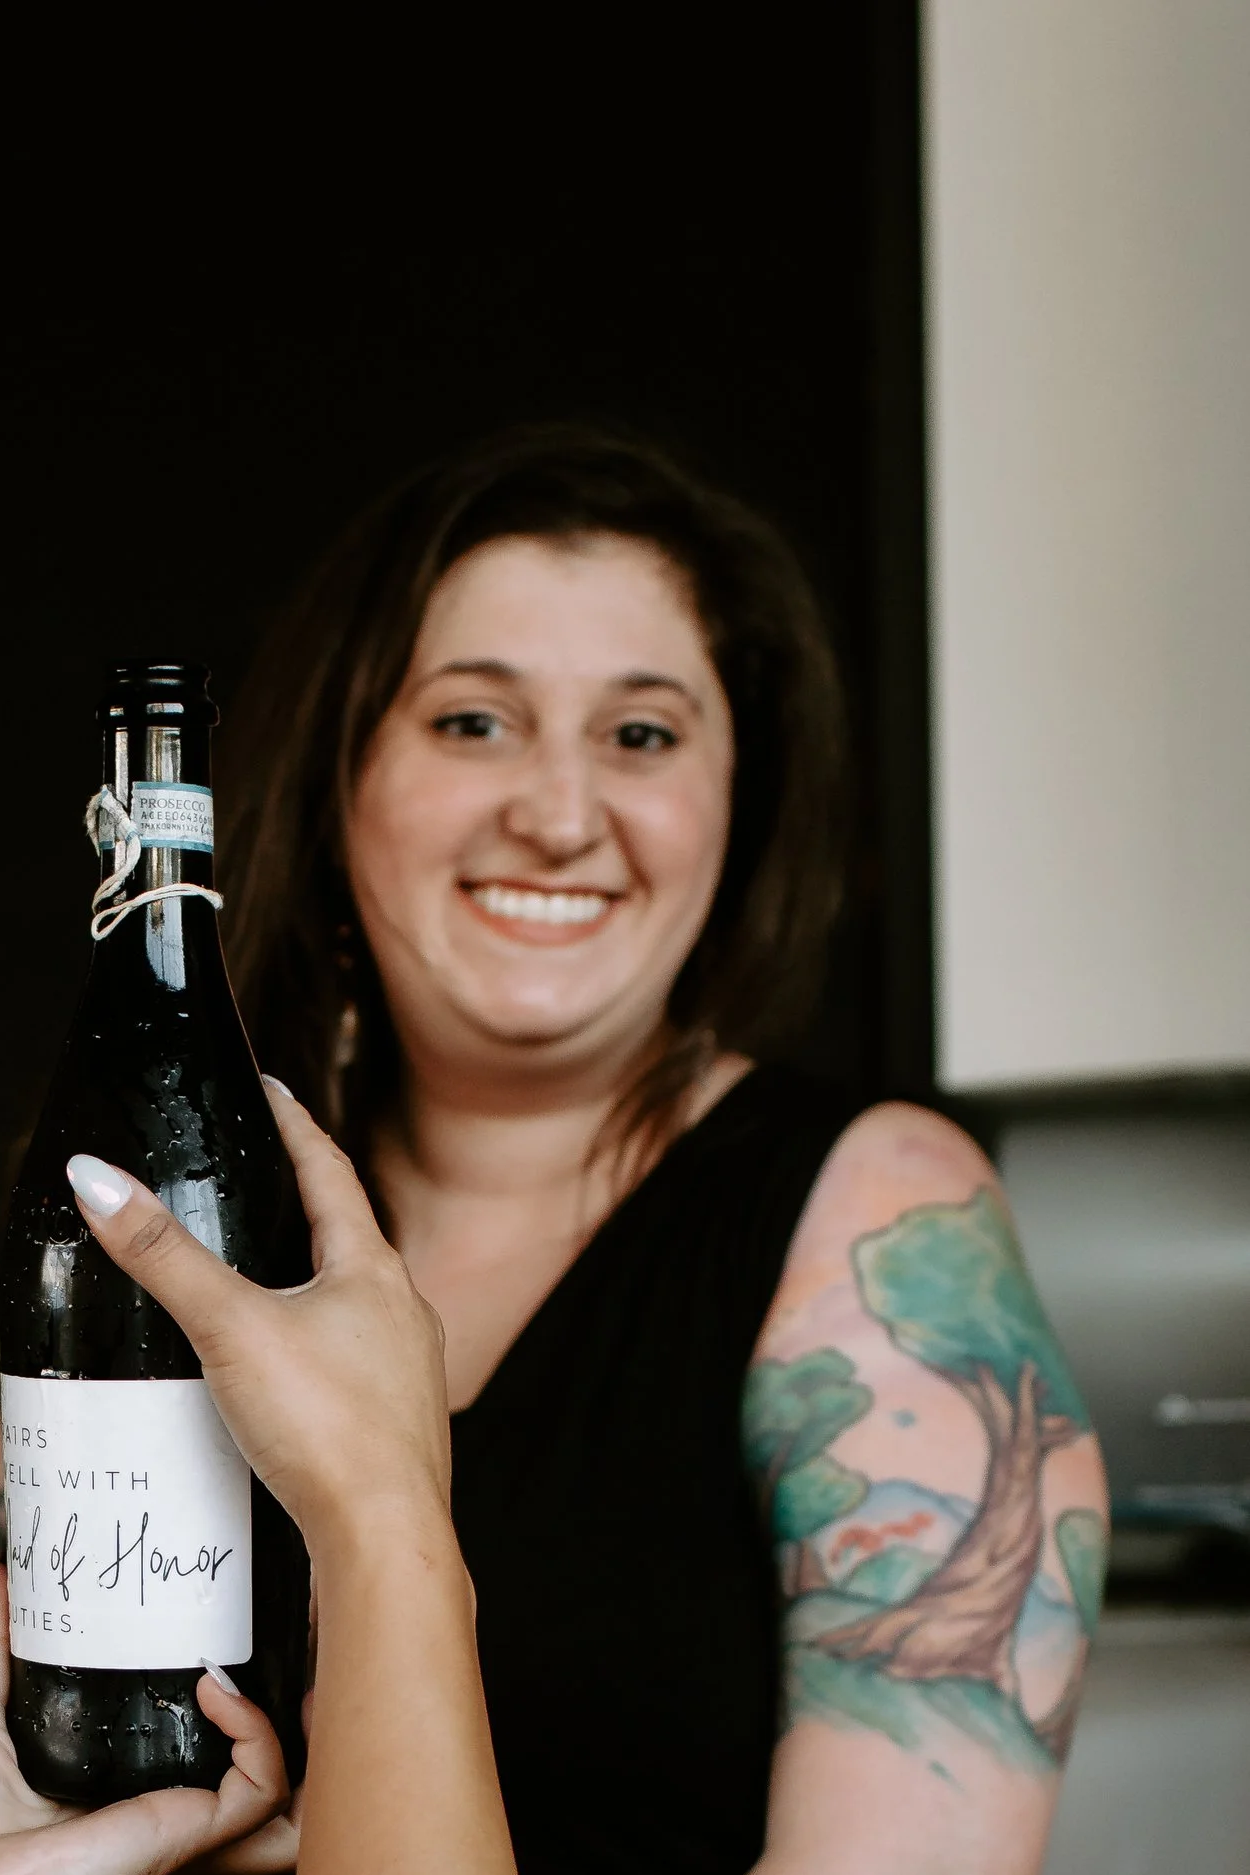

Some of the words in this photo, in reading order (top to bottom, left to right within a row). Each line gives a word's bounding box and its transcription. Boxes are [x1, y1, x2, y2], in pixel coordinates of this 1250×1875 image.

[140, 798, 206, 812] PROSECCO
[4, 1425, 48, 1449] AIRS
[5, 1463, 40, 1488] ELL
[58, 1469, 149, 1491] WITH
[50, 1512, 86, 1602] of
[98, 1511, 233, 1607] Honor
[12, 1605, 84, 1634] UTIES.
